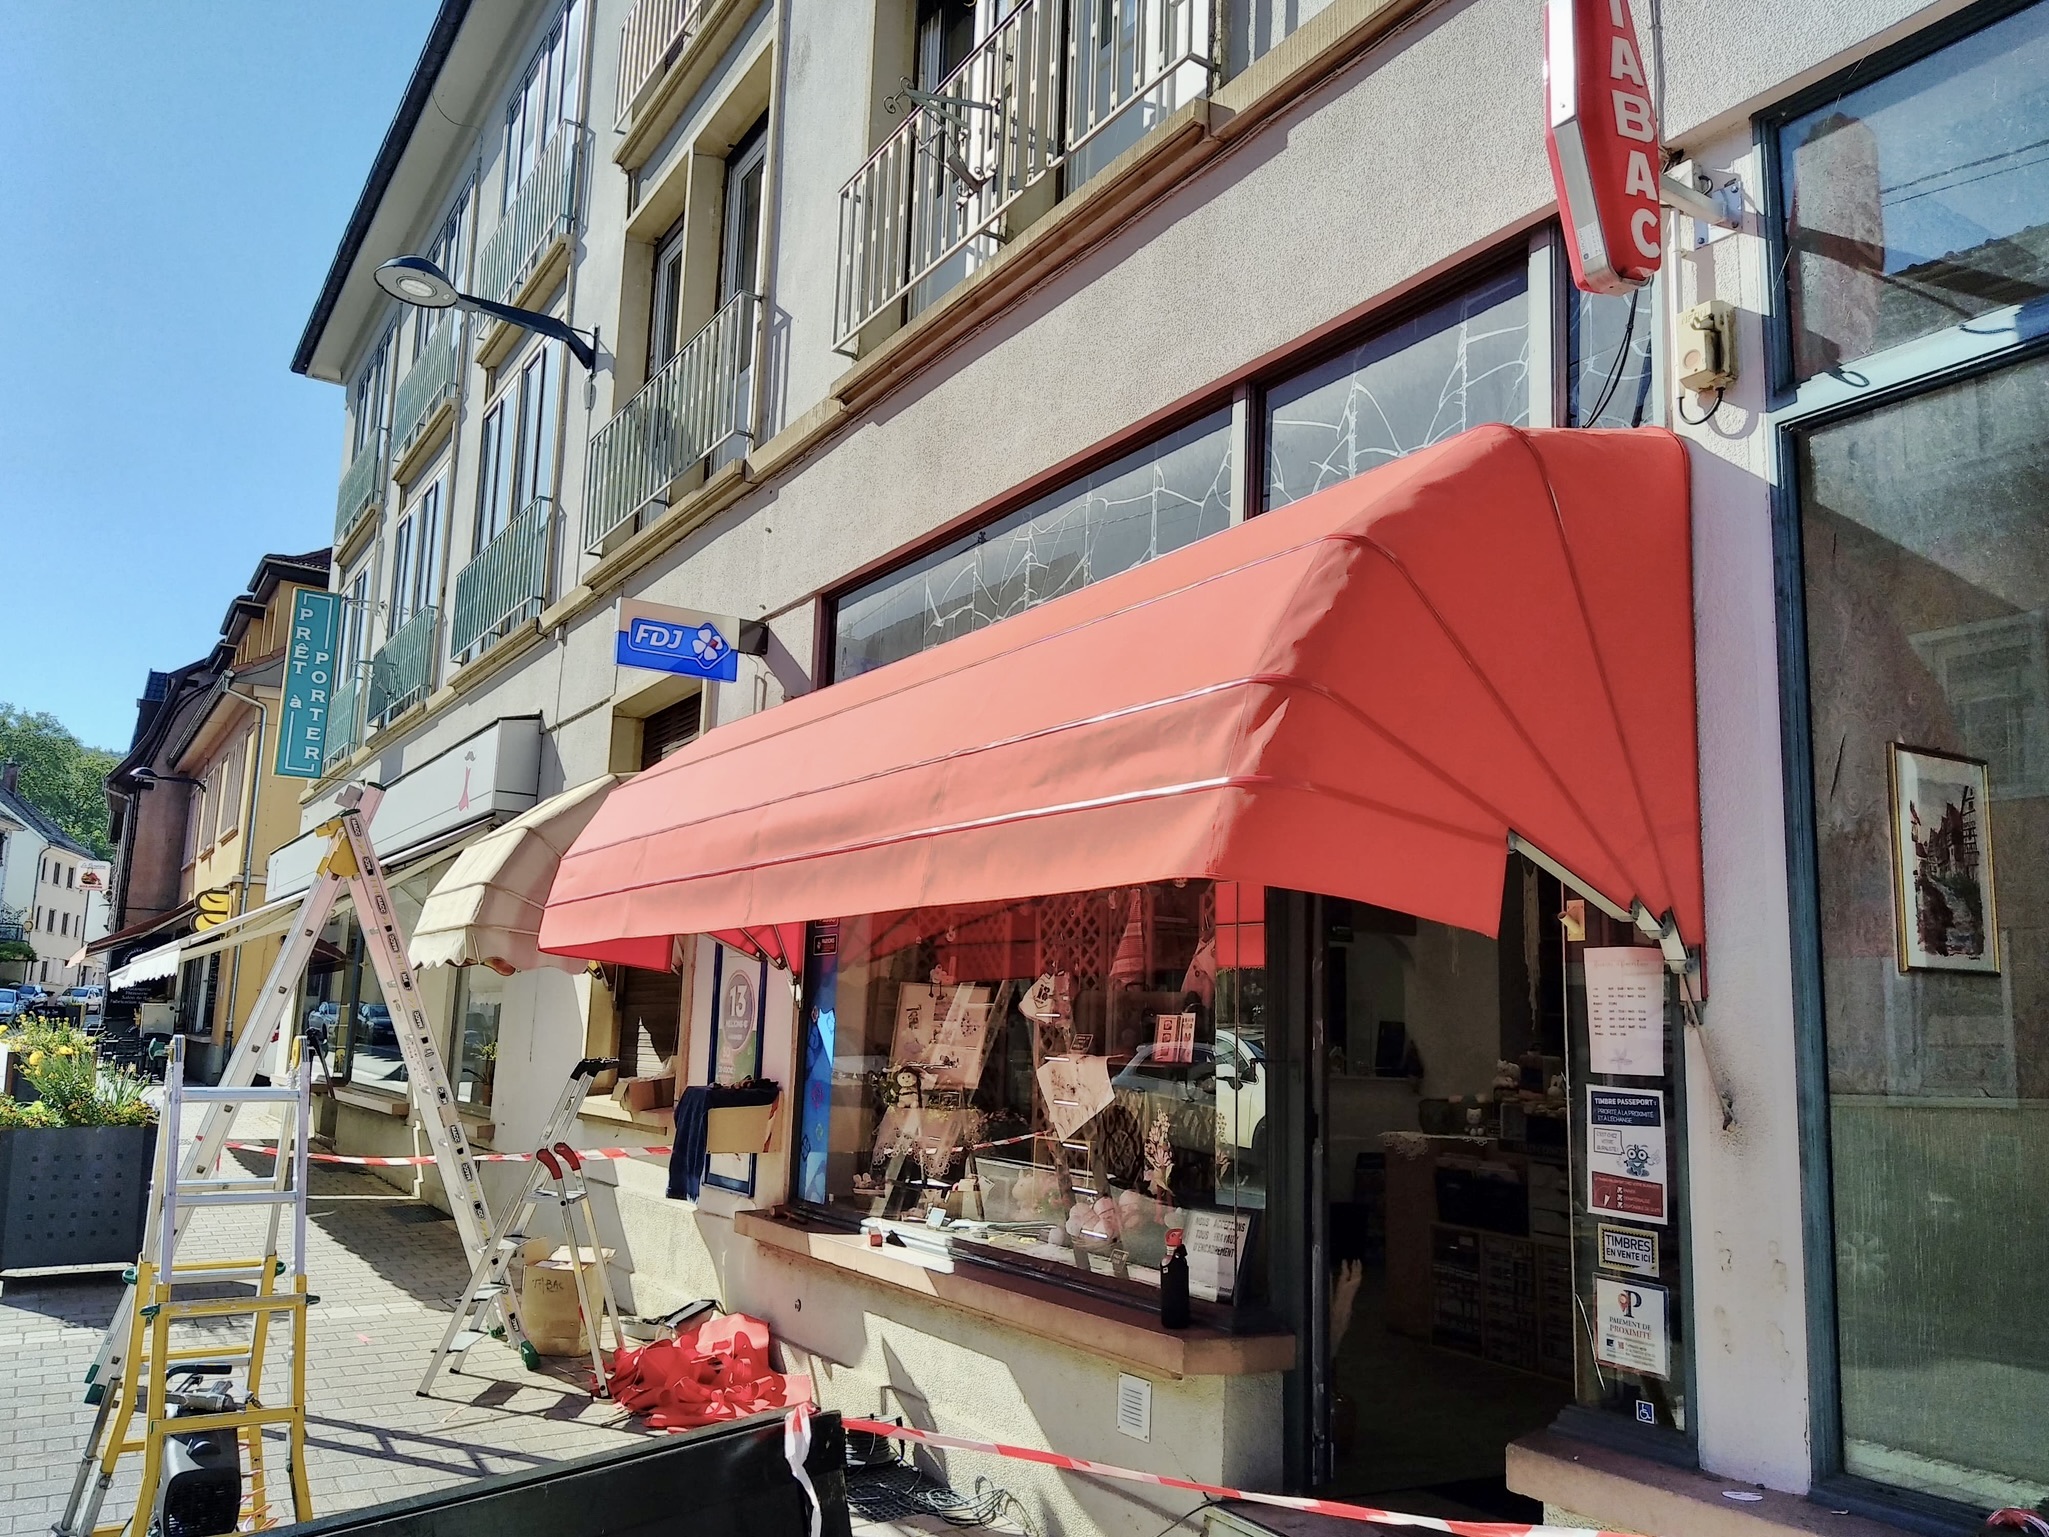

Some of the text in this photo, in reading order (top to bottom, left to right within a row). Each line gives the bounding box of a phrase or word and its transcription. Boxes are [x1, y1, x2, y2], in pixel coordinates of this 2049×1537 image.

[292, 607, 315, 675] PRÊT
[635, 624, 684, 649] FDJ
[289, 694, 303, 709] à
[304, 651, 330, 761] PORTER
[729, 984, 748, 1018] 13
[1594, 1097, 1616, 1105] TIMBRE
[1617, 1098, 1653, 1106] PASSEPORT
[1605, 1234, 1651, 1252] TIMBRES
[1606, 1247, 1651, 1263] EN VENTE ICI
[1609, 1316, 1652, 1331] PAIEMENT DE
